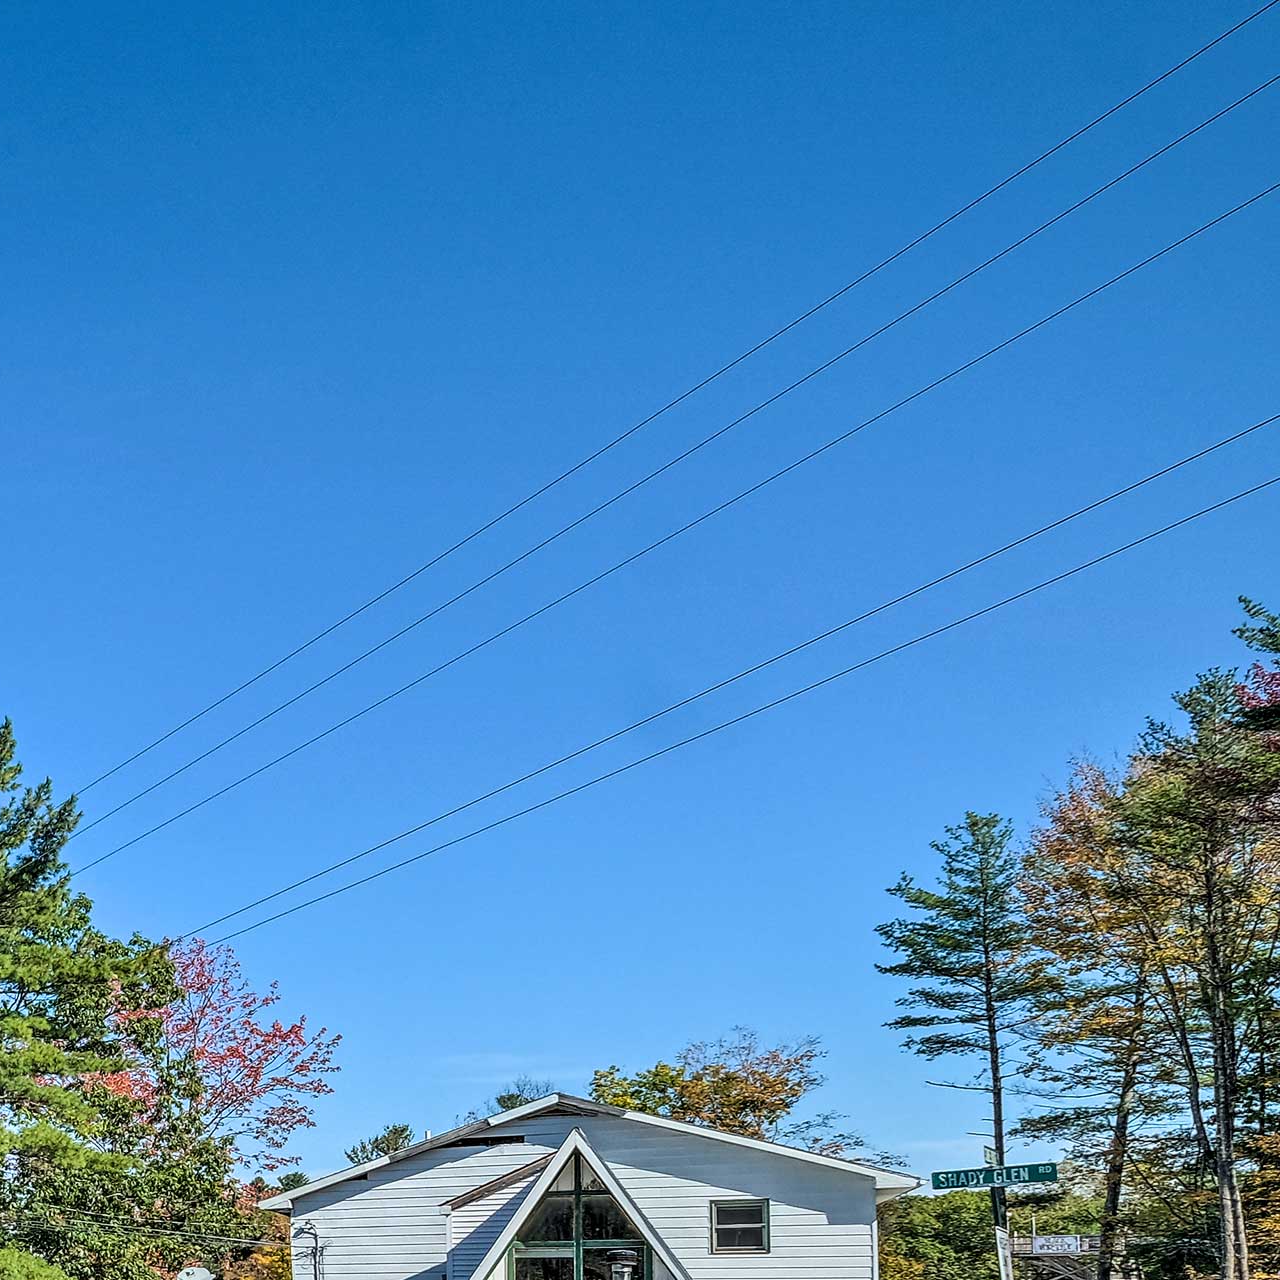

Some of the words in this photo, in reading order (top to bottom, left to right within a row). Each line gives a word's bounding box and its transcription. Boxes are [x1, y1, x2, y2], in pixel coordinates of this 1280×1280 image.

[938, 1171, 985, 1188] SHADY
[993, 1167, 1029, 1183] GLEN
[1038, 1165, 1052, 1174] RD
